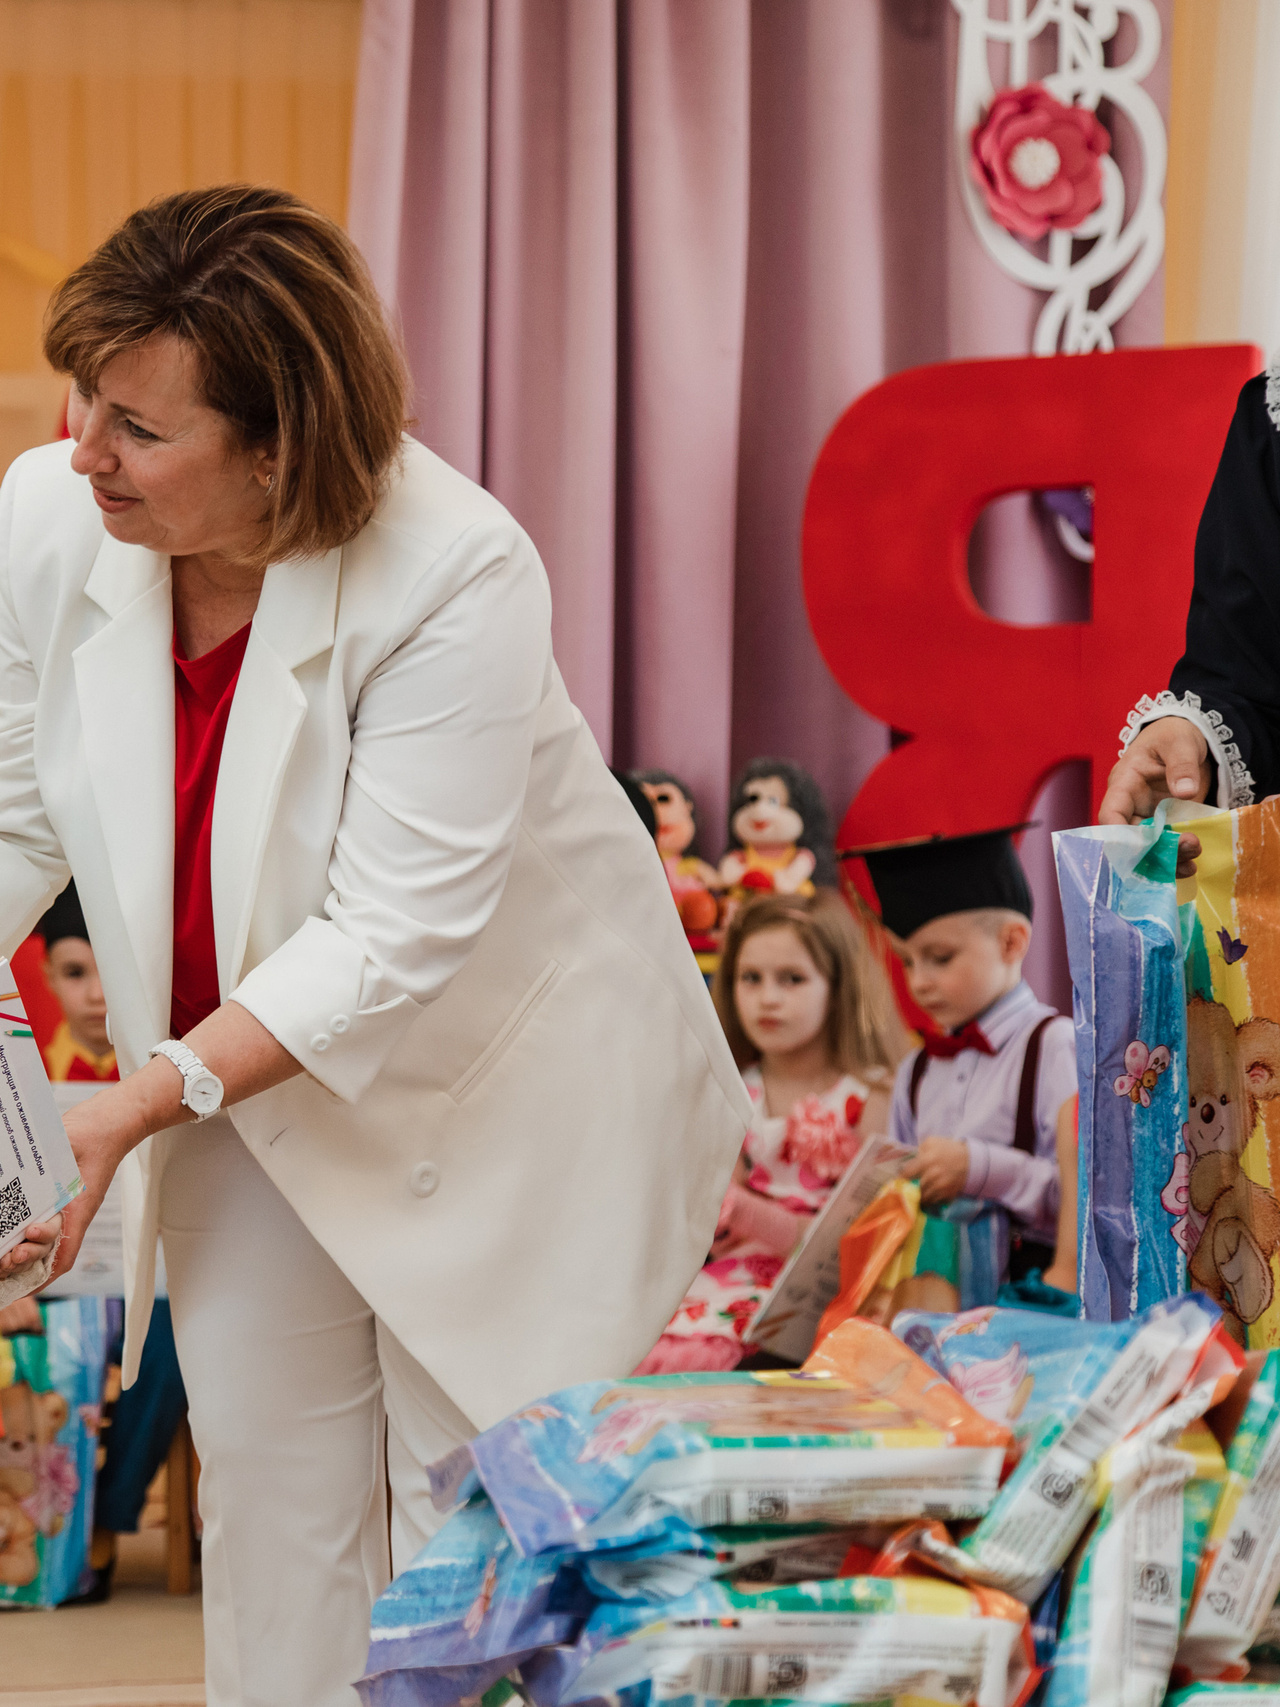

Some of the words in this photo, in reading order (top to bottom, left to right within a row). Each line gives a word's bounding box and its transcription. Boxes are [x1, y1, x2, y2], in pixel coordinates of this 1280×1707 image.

[800, 342, 1263, 960] Я
[12, 1090, 19, 1101] по
[1, 1113, 13, 1134] способ
[9, 1134, 24, 1170] оживления:
[15, 1101, 34, 1144] оживлению
[30, 1145, 45, 1175] альбома
